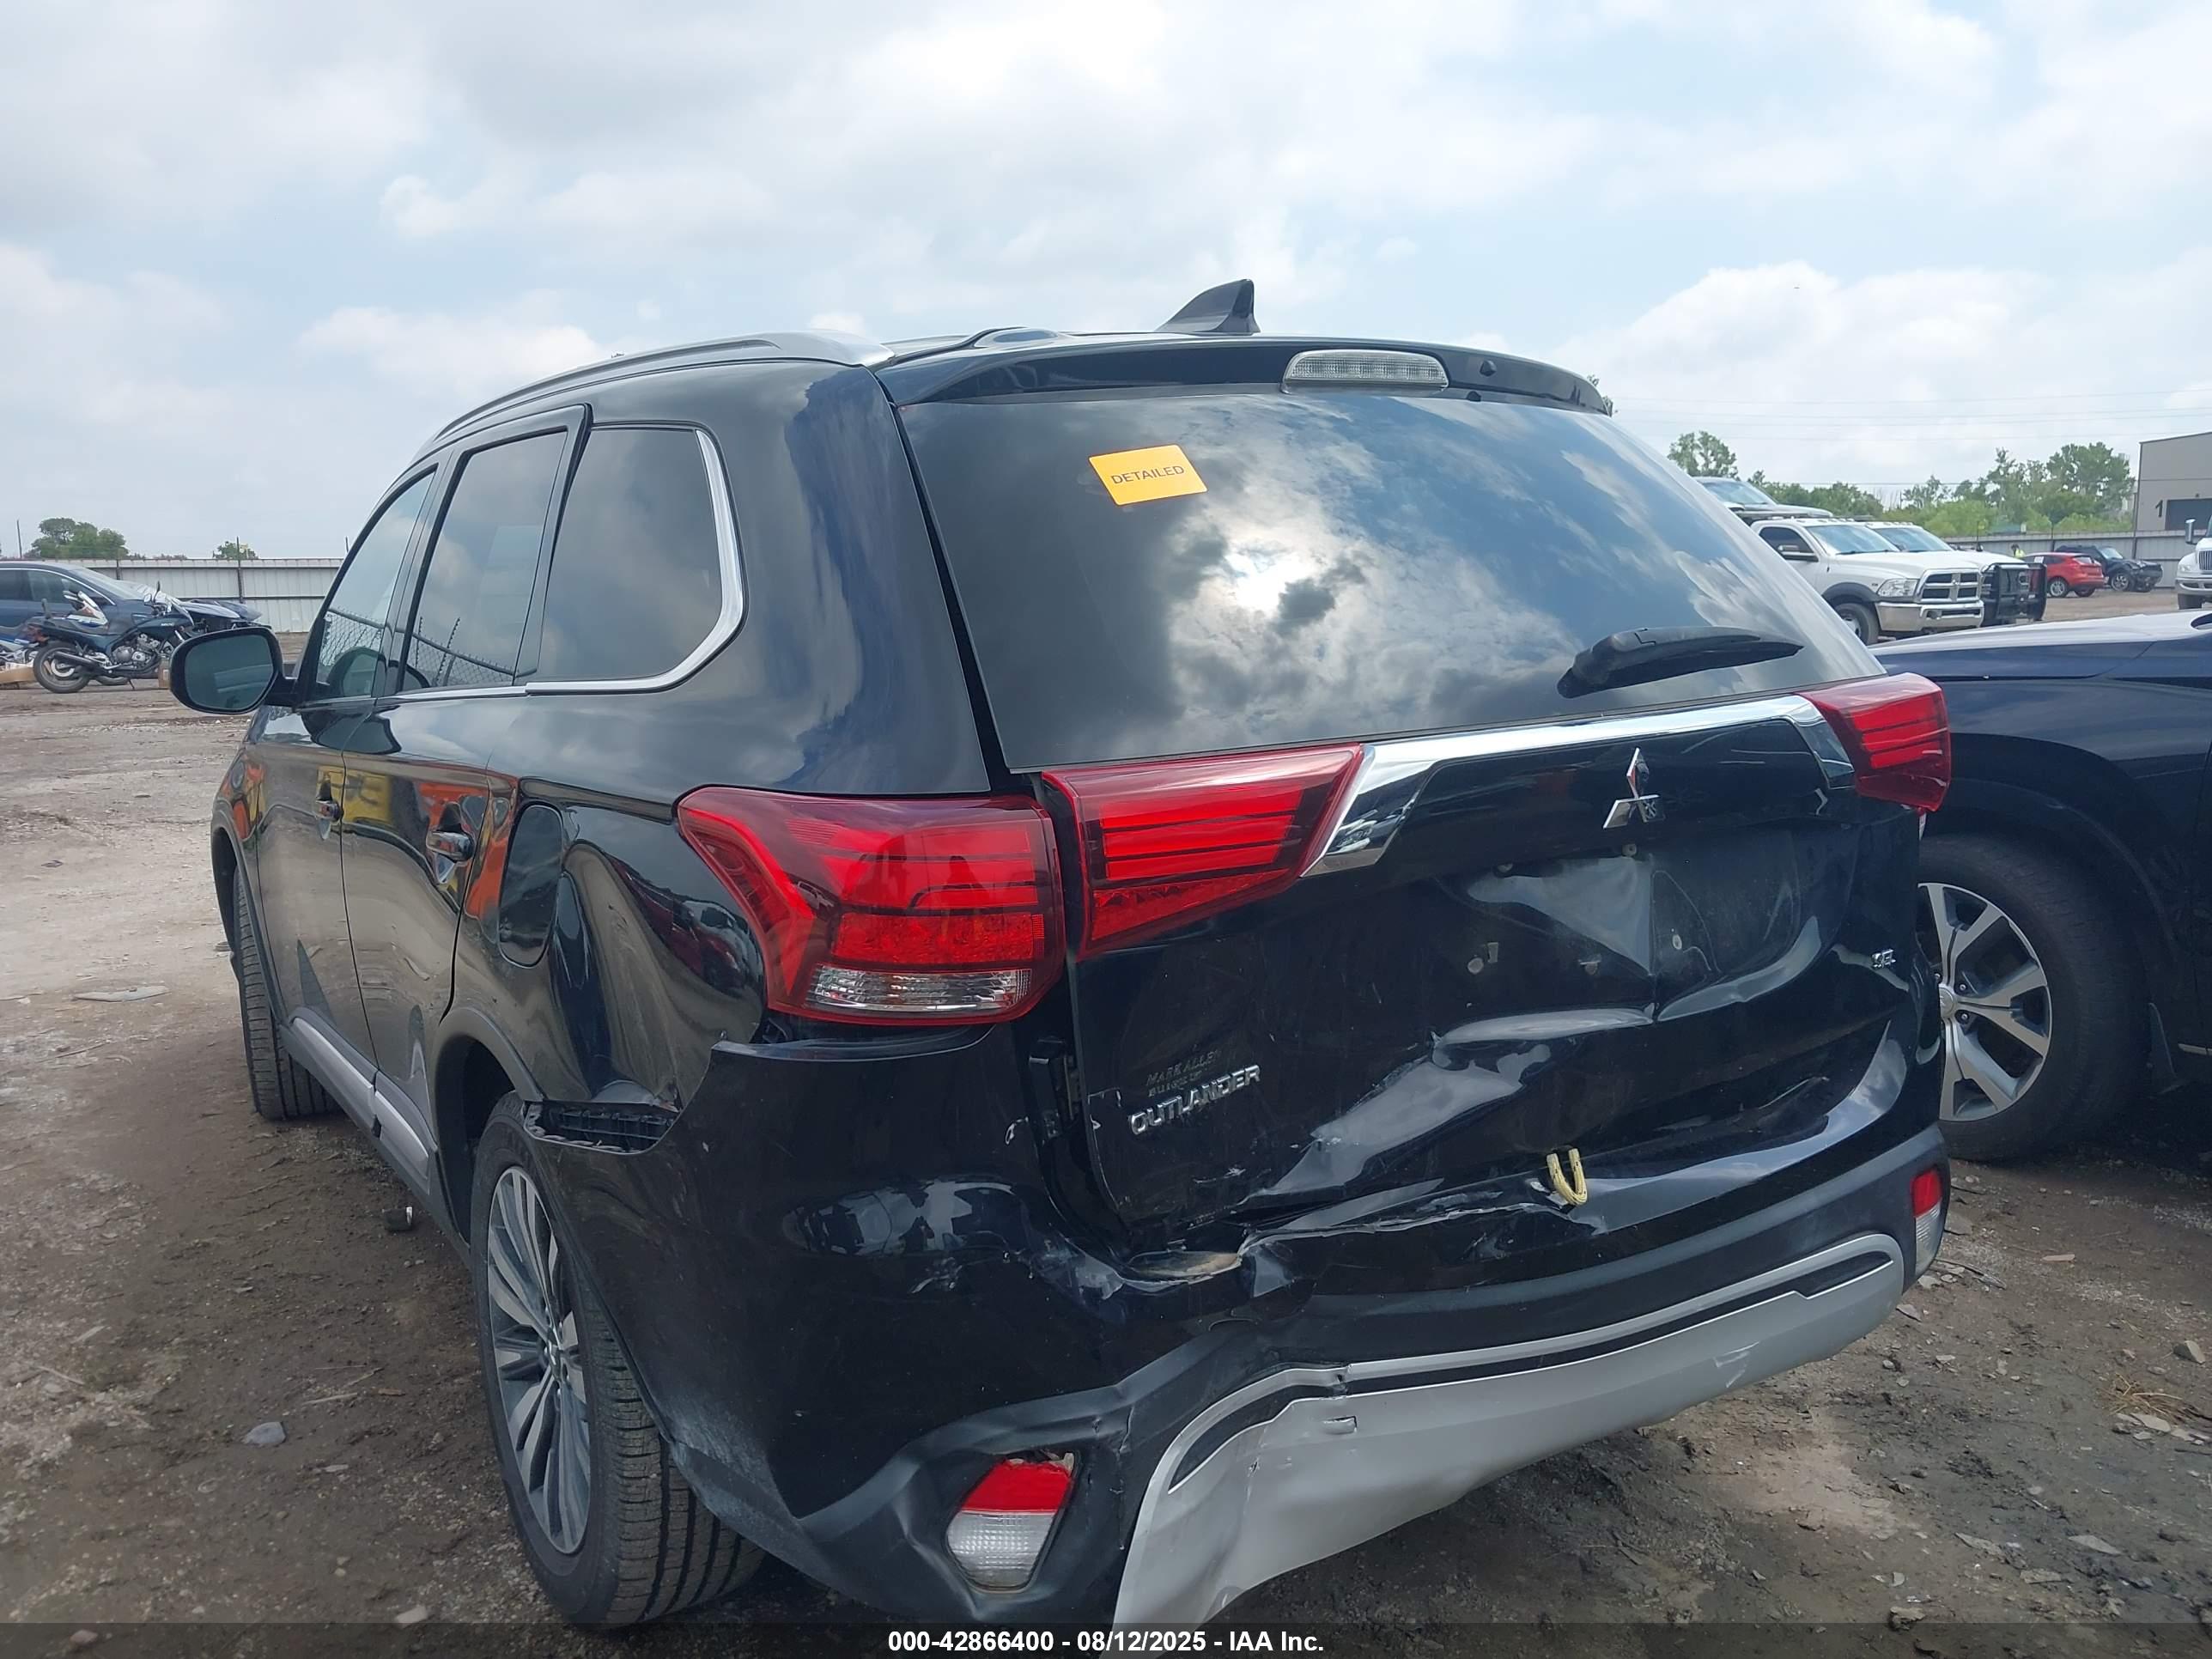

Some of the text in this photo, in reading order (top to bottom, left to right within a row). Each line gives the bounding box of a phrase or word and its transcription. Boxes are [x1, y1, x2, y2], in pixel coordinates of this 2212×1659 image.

[1111, 465, 1184, 484] DETAILED
[2155, 499, 2163, 518] 1
[1128, 1064, 1261, 1135] OUTLANDER
